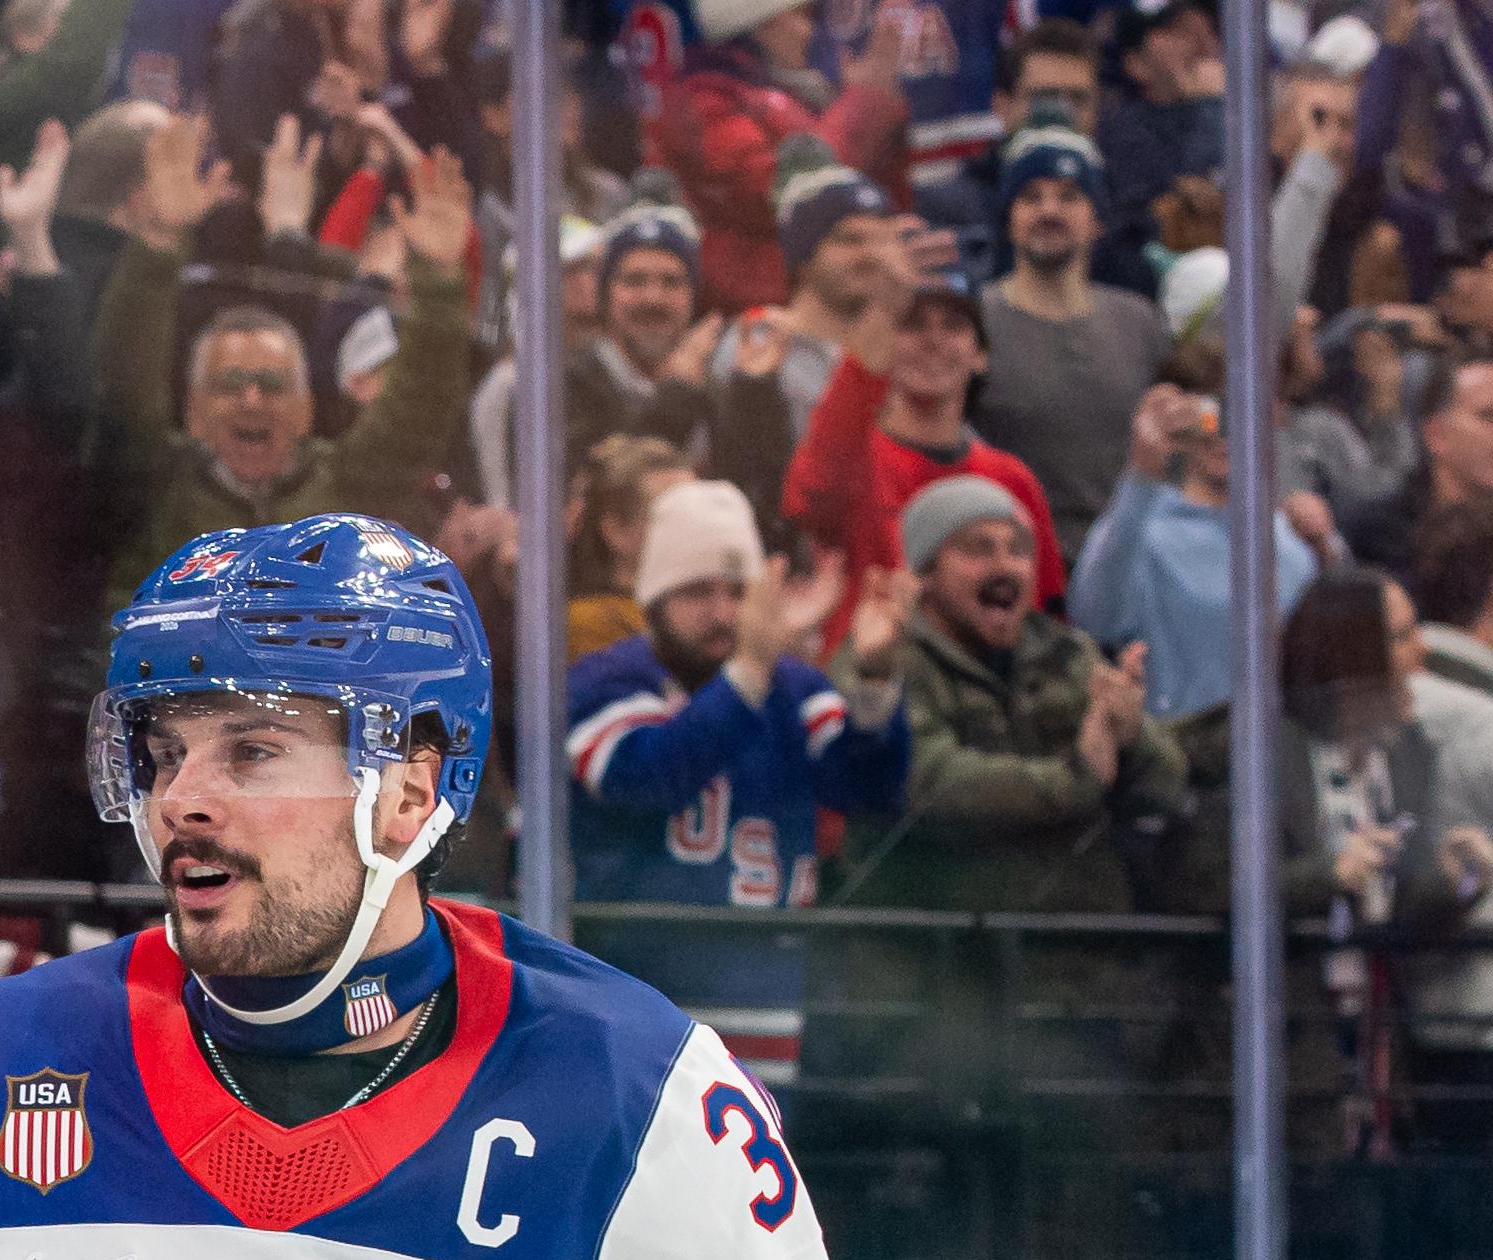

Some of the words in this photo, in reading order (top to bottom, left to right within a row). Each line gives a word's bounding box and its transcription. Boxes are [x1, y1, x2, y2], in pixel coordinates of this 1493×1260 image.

[351, 982, 380, 998] USA
[19, 1083, 72, 1105] USA
[457, 1117, 536, 1248] C
[702, 1065, 797, 1234] 3
